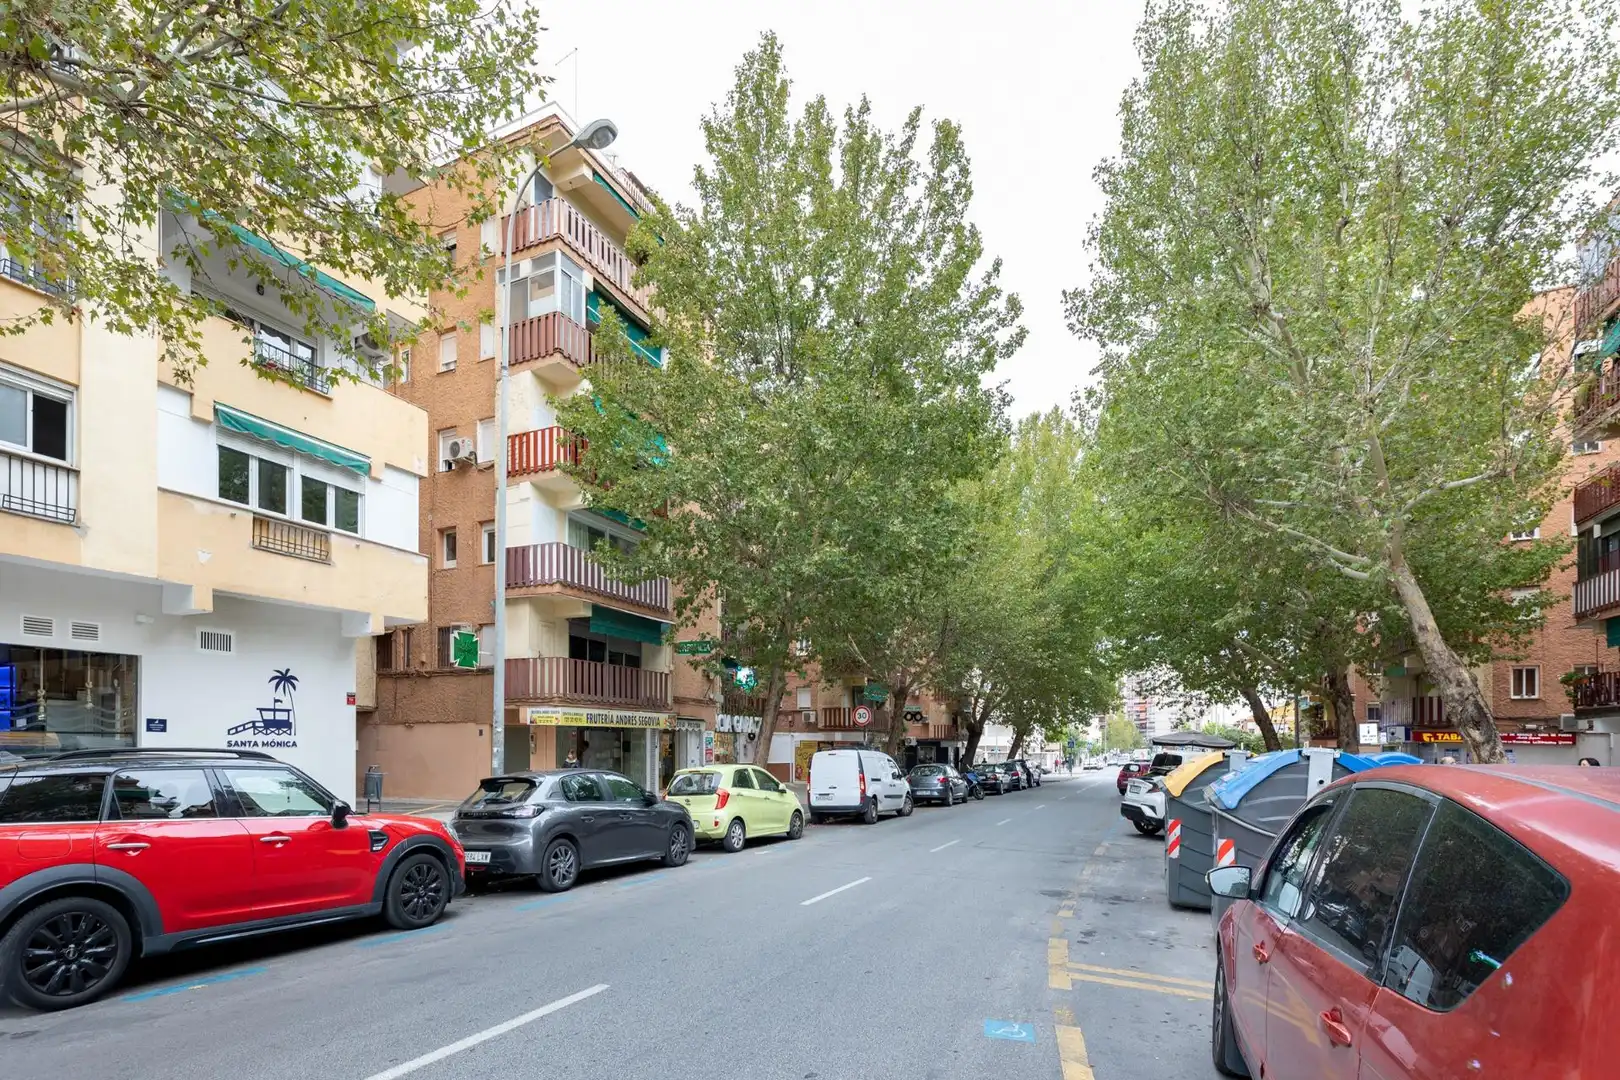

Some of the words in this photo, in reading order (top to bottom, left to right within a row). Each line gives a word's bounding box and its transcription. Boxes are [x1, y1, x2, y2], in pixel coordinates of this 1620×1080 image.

[586, 711, 614, 724] FRUTERÍA
[616, 713, 637, 725] ANDRÉS
[639, 715, 660, 726] SEGOVIA
[226, 740, 259, 748] SANTA
[261, 738, 298, 748] MÓNICA
